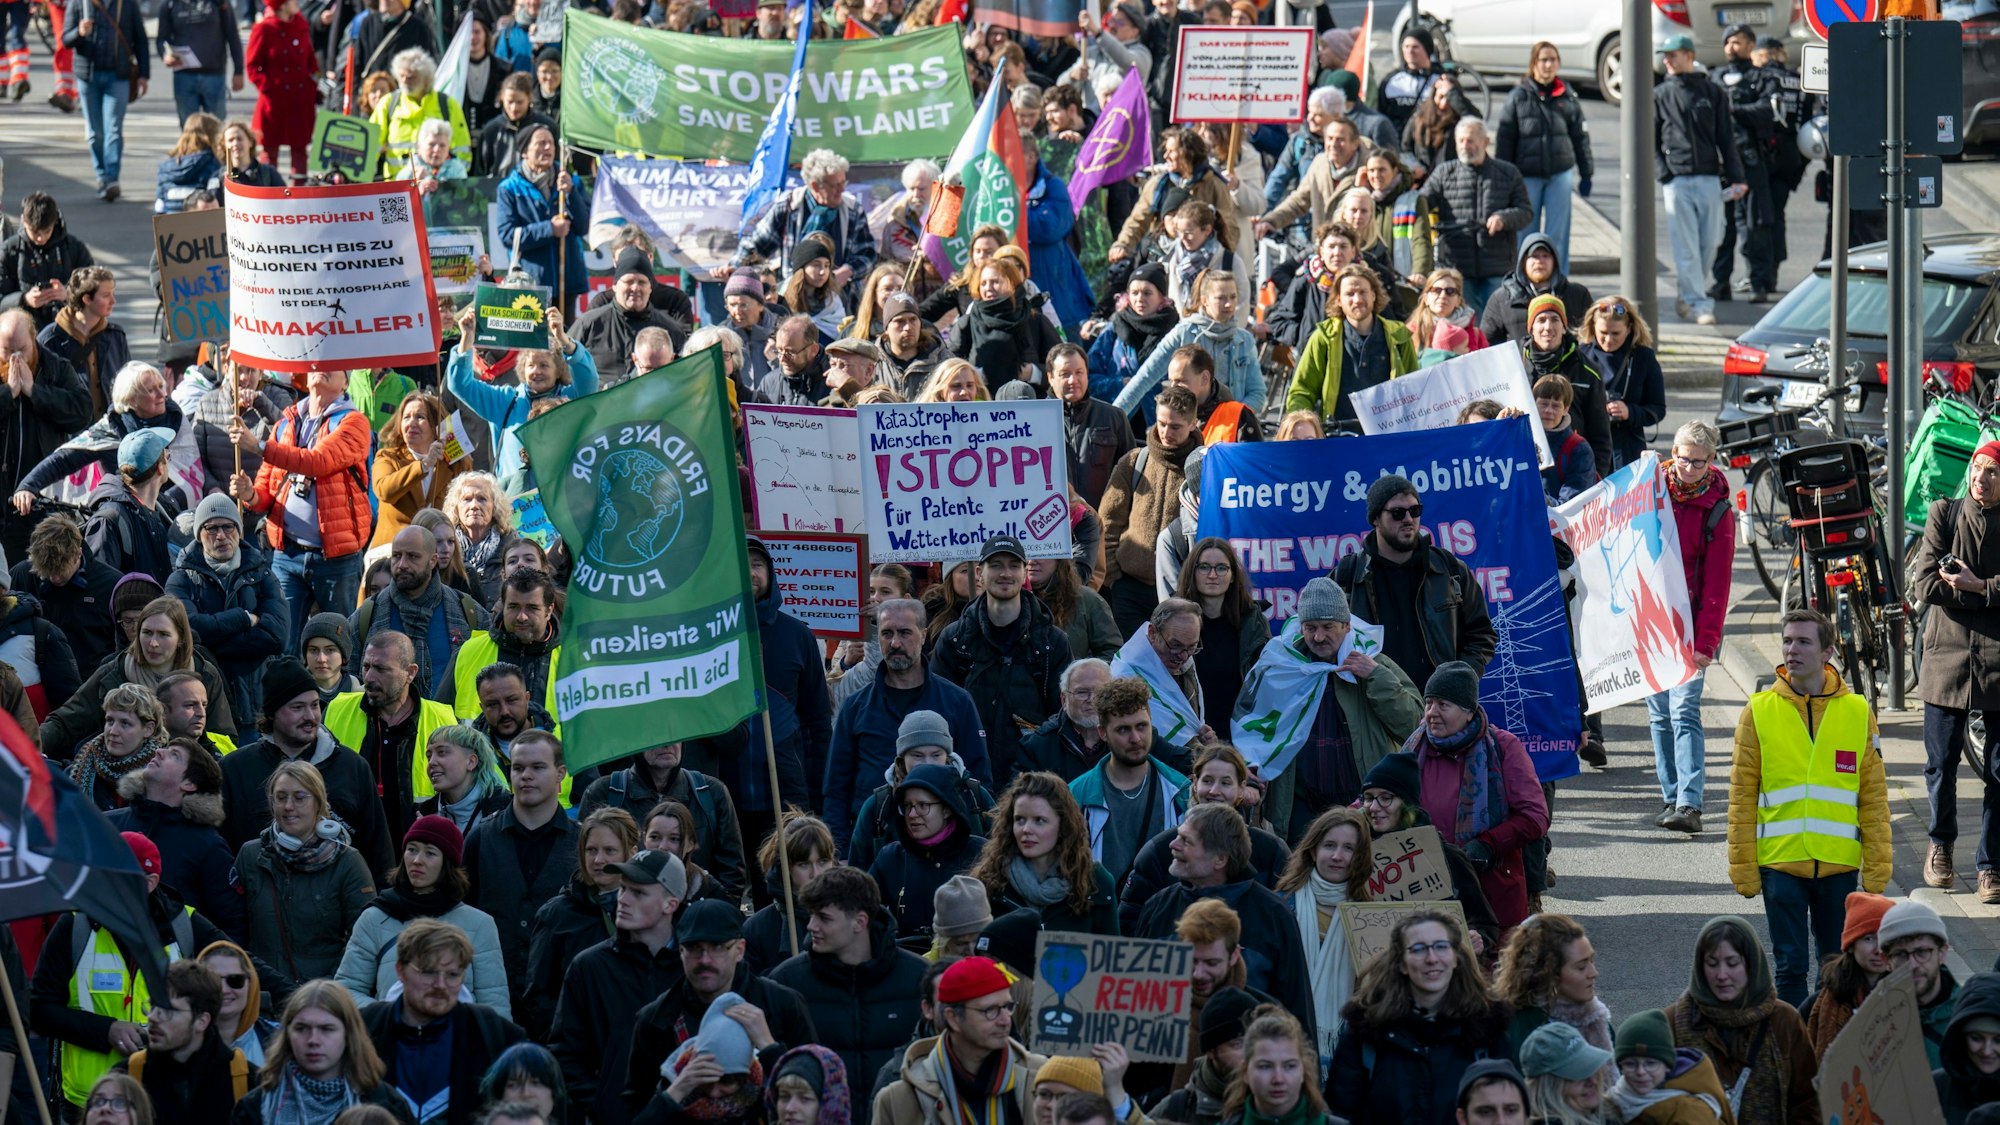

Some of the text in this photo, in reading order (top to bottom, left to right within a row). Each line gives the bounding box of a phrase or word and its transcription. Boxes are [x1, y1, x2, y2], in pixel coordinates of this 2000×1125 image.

[674, 55, 949, 104] STOP WARS
[1811, 66, 1828, 76] Seit
[1187, 93, 1293, 102] KLIMAKILLER
[678, 101, 954, 138] SAVE HE PLANET
[640, 184, 721, 209] FÜHRT
[230, 207, 375, 225] DAS VERSPRÜHEN
[230, 235, 394, 255] VON JÄHRLICH BIS ZU
[236, 257, 318, 273] MILLIONEN
[323, 256, 405, 272] TONNEN
[294, 287, 314, 295] DIE
[316, 280, 411, 294] ATMOSPHÄRE
[301, 299, 327, 308] DER
[481, 306, 501, 317] KLIMA
[169, 299, 231, 342] ÖPN
[233, 312, 413, 337] KLIMAKILLER
[488, 318, 532, 331] JOBS SICHERN
[1371, 391, 1420, 416] Preisfrage:
[1378, 419, 1394, 432] Wo
[1395, 411, 1416, 428] wird
[1416, 406, 1432, 421] die
[1432, 393, 1468, 413] Gentech
[1467, 390, 1482, 402] 2.0
[1482, 380, 1511, 397] künftig
[749, 415, 766, 426] Das
[875, 406, 1017, 431] Katastrophen von
[870, 421, 1033, 452] Menschen gemacht
[846, 452, 857, 461] 20
[1220, 477, 1332, 514] Energy
[1342, 470, 1368, 502] &
[884, 496, 1029, 528] für Patente zur
[1030, 501, 1063, 534] Patent
[766, 543, 790, 552] ENT
[1228, 537, 1296, 573] THE
[1437, 519, 1477, 556] IS
[774, 568, 857, 578] RWAFFEN
[779, 583, 799, 592] ZE
[784, 595, 858, 608] BRÄNDE
[800, 611, 856, 620] ERZEUGT!
[1520, 739, 1576, 753] TEIGNEN
[1836, 762, 1856, 772] ver.di
[1368, 848, 1424, 896] NOT
[1095, 975, 1190, 1015] RENNT
